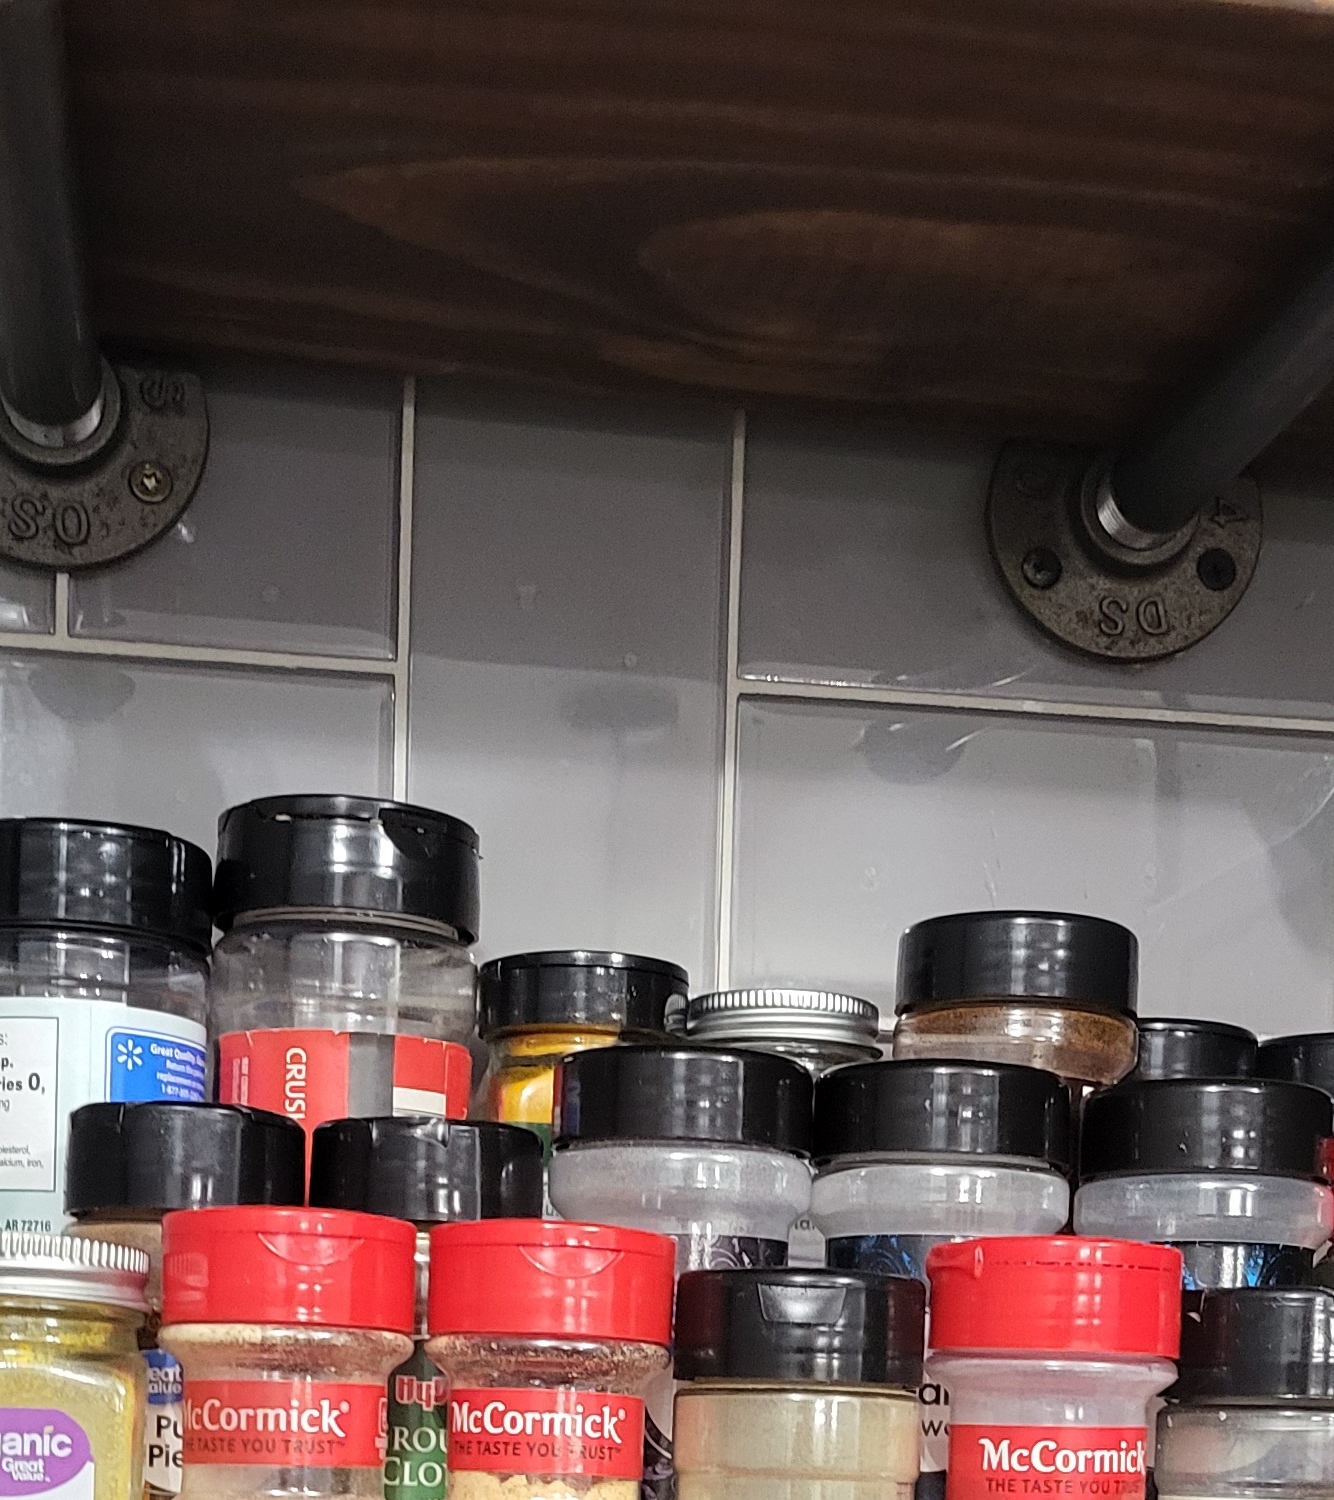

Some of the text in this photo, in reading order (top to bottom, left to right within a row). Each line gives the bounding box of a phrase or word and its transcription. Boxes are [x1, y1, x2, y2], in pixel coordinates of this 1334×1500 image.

[150, 1043, 174, 1058] Great
[284, 1046, 307, 1121] CRUS
[5, 1220, 18, 1231] AR
[21, 1220, 51, 1232] 72716
[148, 1380, 182, 1395] alue
[452, 1401, 622, 1443] McCormick
[241, 1438, 277, 1454] YOU
[477, 1440, 521, 1457] TASTE
[527, 1442, 561, 1458] YOU
[978, 1438, 1146, 1475] McCormick
[1, 1458, 45, 1474] Great
[11, 1468, 47, 1482] Value
[985, 1477, 1110, 1494] THE TASTE YOU
